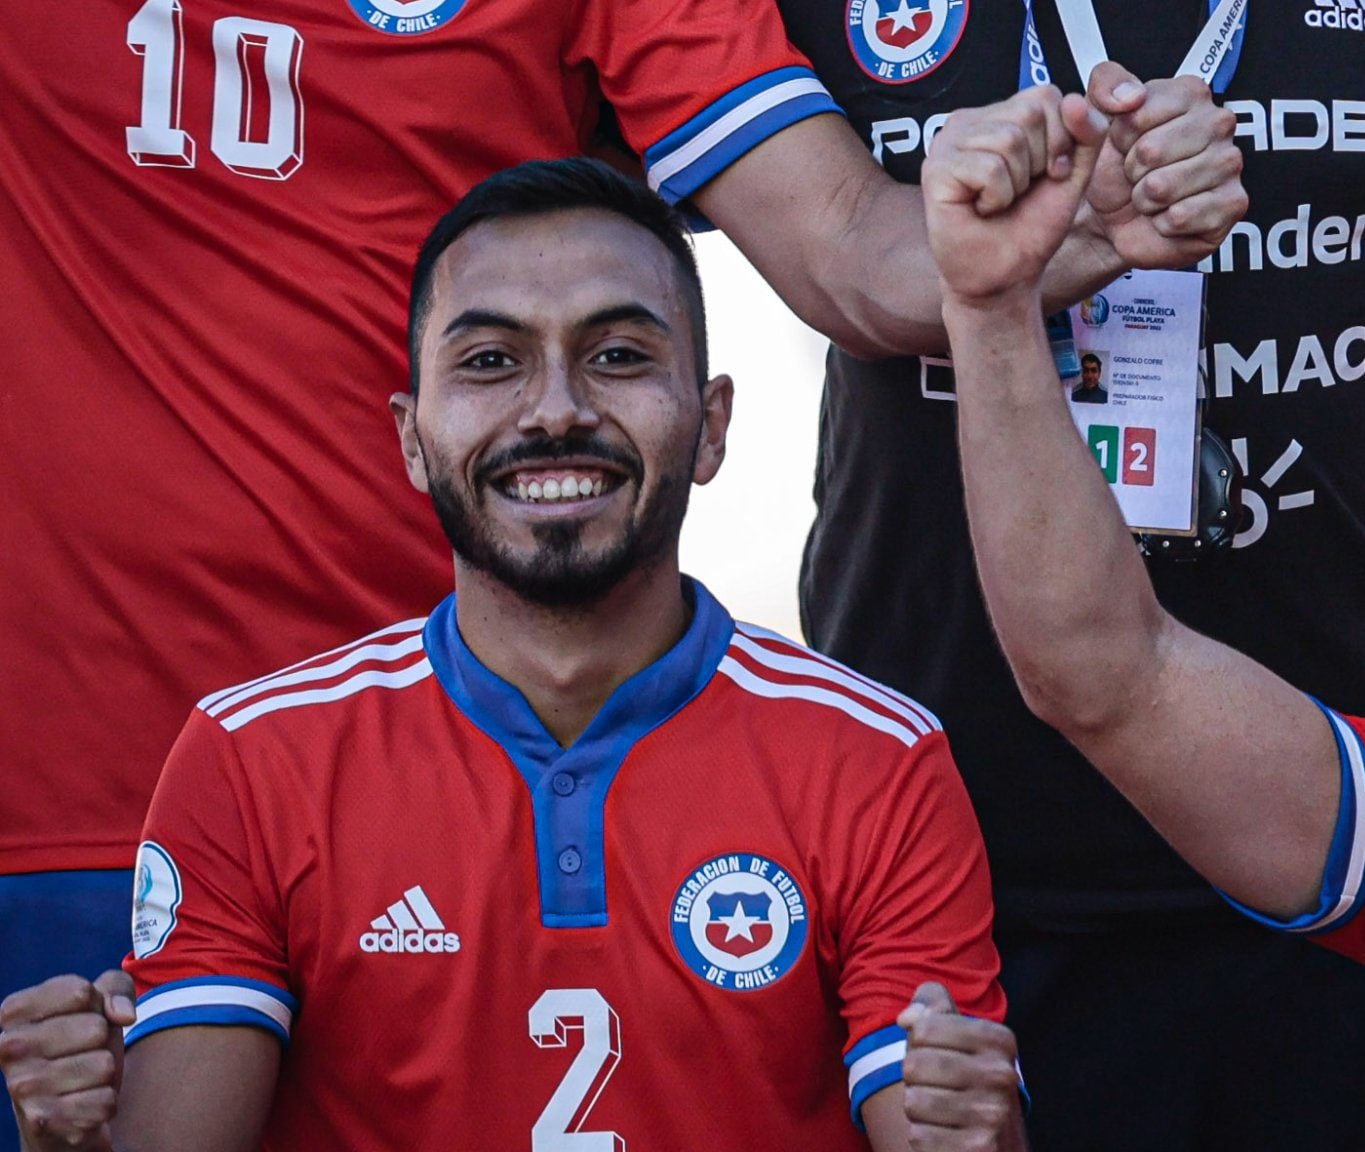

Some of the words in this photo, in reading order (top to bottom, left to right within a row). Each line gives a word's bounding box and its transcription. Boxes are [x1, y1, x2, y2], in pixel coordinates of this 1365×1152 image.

[368, 10, 391, 29] DE
[396, 13, 438, 32] CHILE
[878, 61, 895, 78] DE
[901, 50, 937, 77] CHILE
[1199, 38, 1223, 74] COPA
[1112, 304, 1135, 314] COPA
[1136, 306, 1176, 317] AMERICA
[1095, 439, 1108, 468] 1
[1129, 442, 1148, 471] 2
[674, 856, 740, 923] FEDERACION
[749, 857, 770, 877] DE
[771, 870, 805, 924] FUTBOL
[360, 928, 460, 953] adidas
[706, 966, 726, 985] DE
[735, 965, 776, 988] CHILE
[528, 988, 625, 1152] 2
